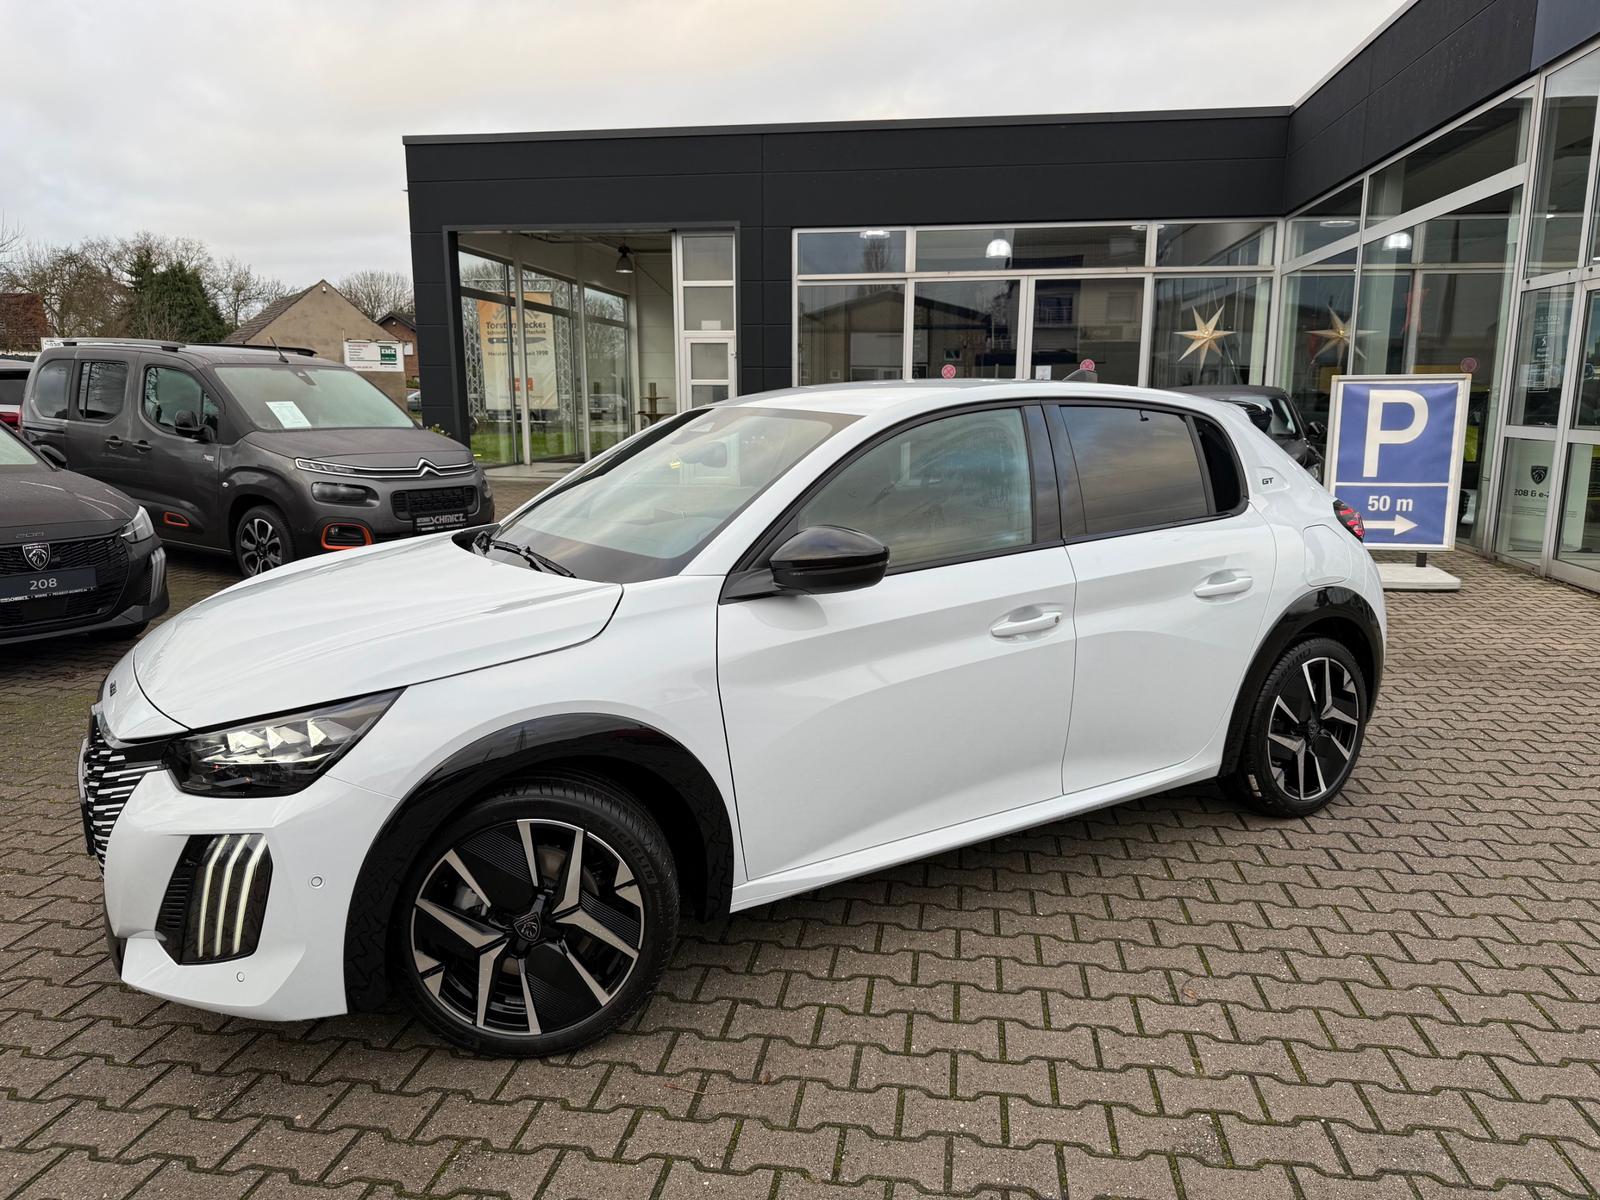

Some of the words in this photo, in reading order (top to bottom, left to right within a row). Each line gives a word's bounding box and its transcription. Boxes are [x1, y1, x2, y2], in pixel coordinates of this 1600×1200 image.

[487, 321, 516, 329] Torstn
[1363, 389, 1429, 478] P
[1261, 476, 1274, 485] GT
[1514, 489, 1529, 497] 208
[1367, 496, 1390, 512] 50
[1396, 499, 1414, 512] m
[30, 578, 57, 590] 208
